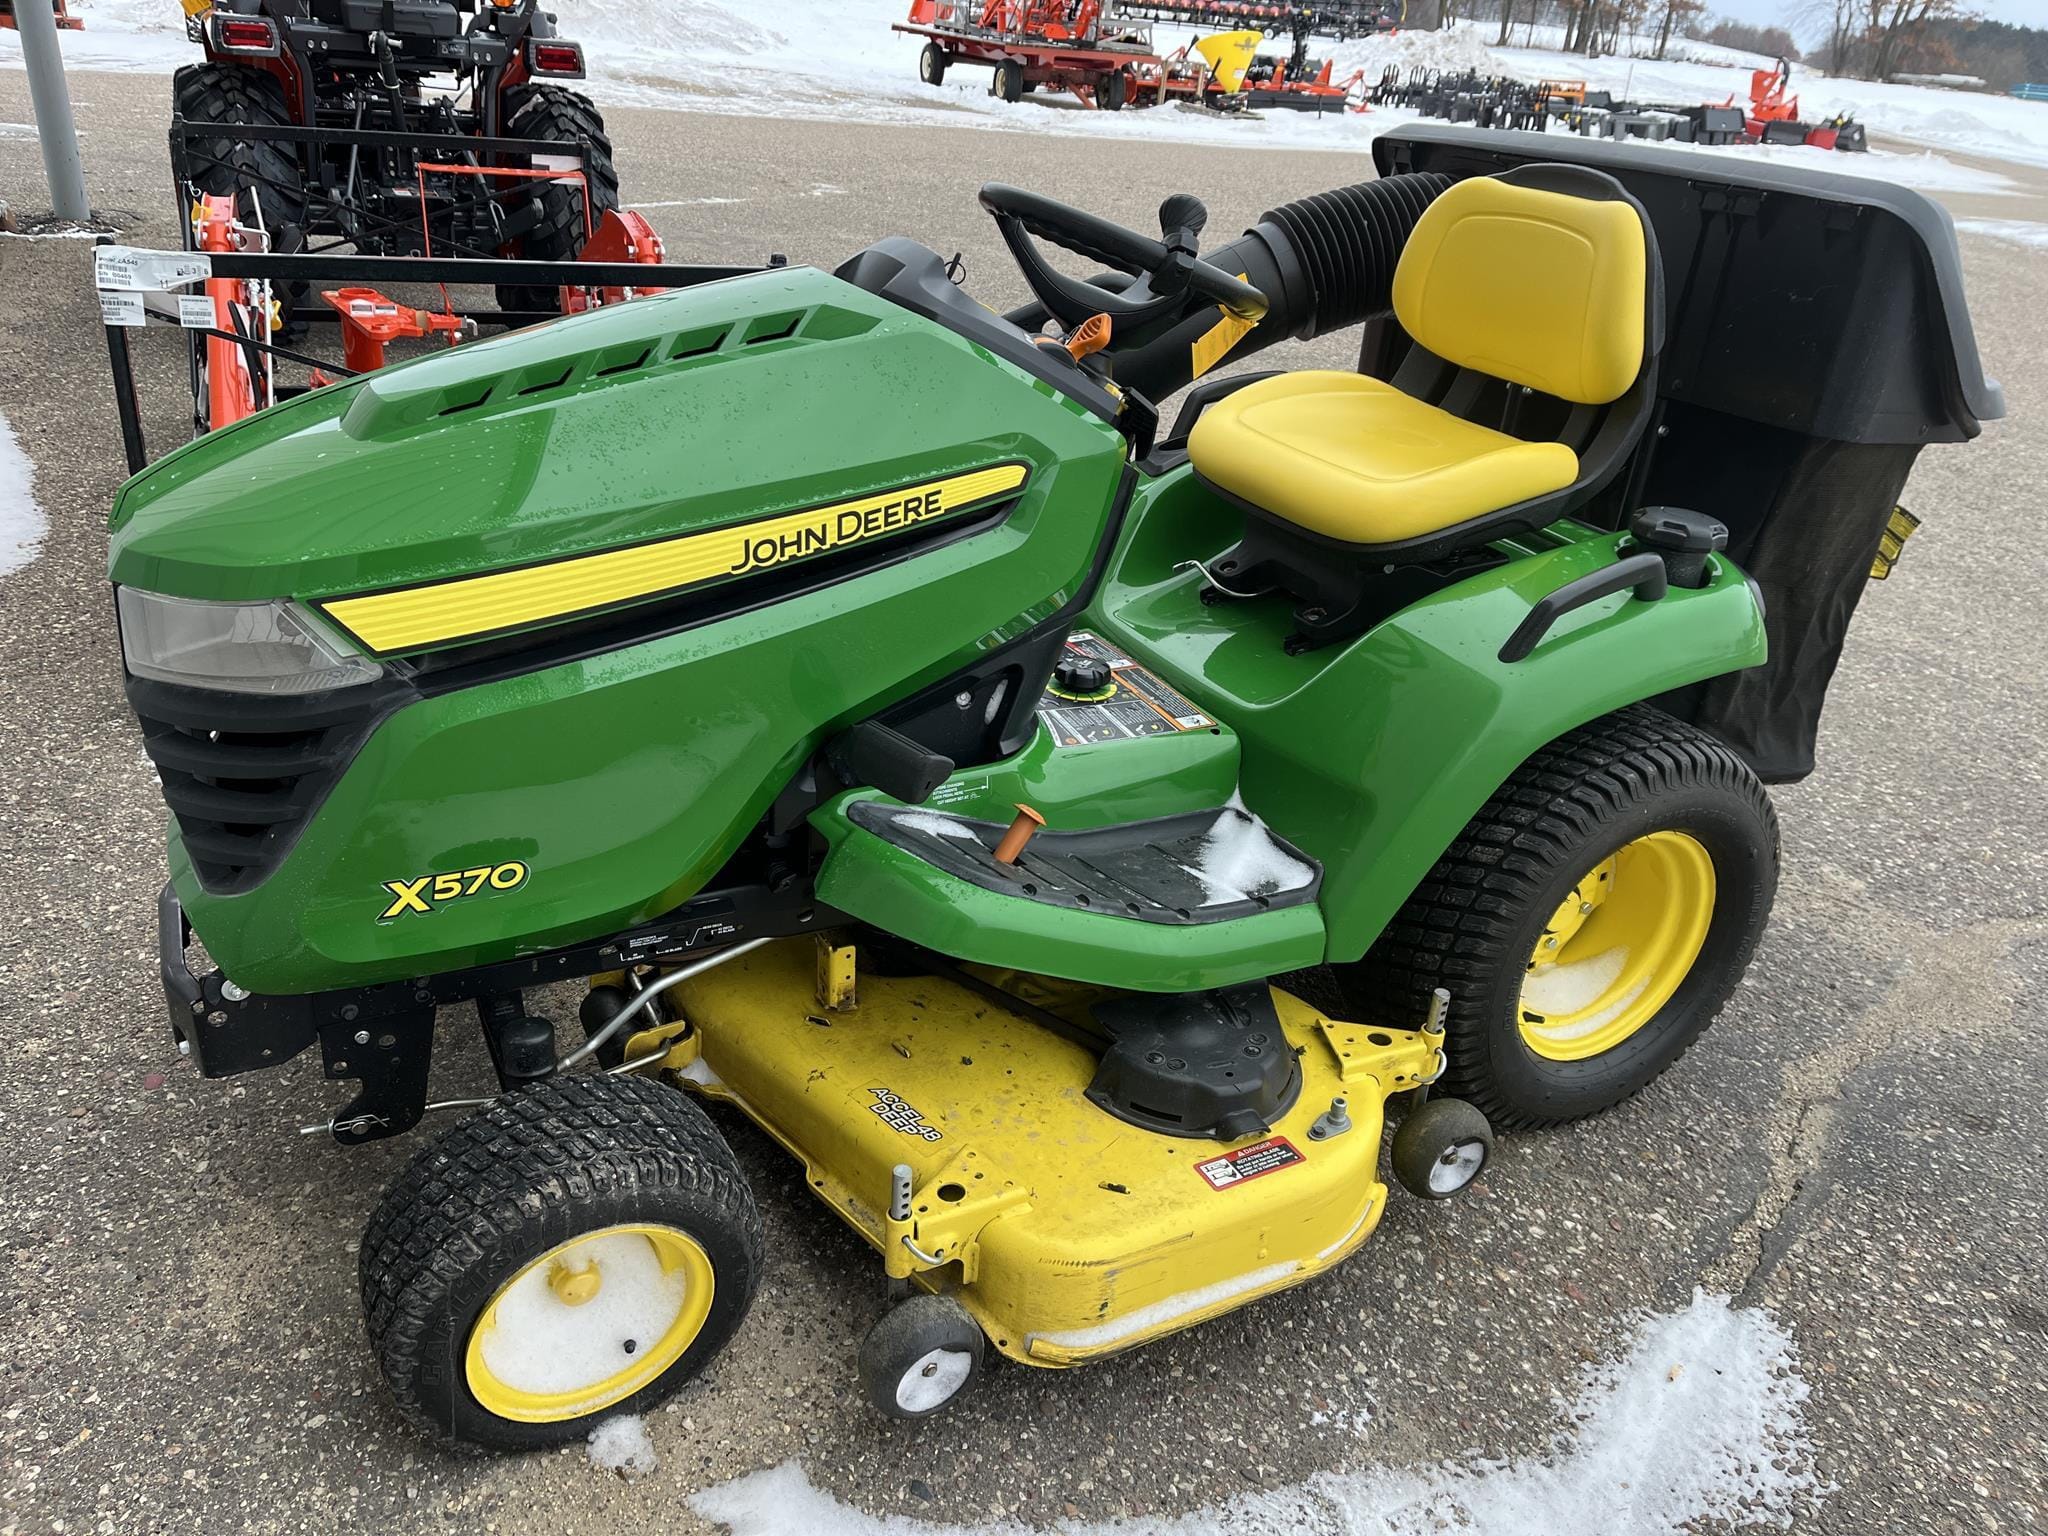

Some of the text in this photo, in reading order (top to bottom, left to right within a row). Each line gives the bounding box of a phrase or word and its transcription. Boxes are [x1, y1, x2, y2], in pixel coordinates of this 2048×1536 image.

[731, 489, 942, 571] JOHN DEERE
[378, 861, 526, 919] X570
[867, 1088, 925, 1127] ACCEL
[868, 1101, 920, 1135] DEEP
[1243, 1141, 1272, 1154] DANGER
